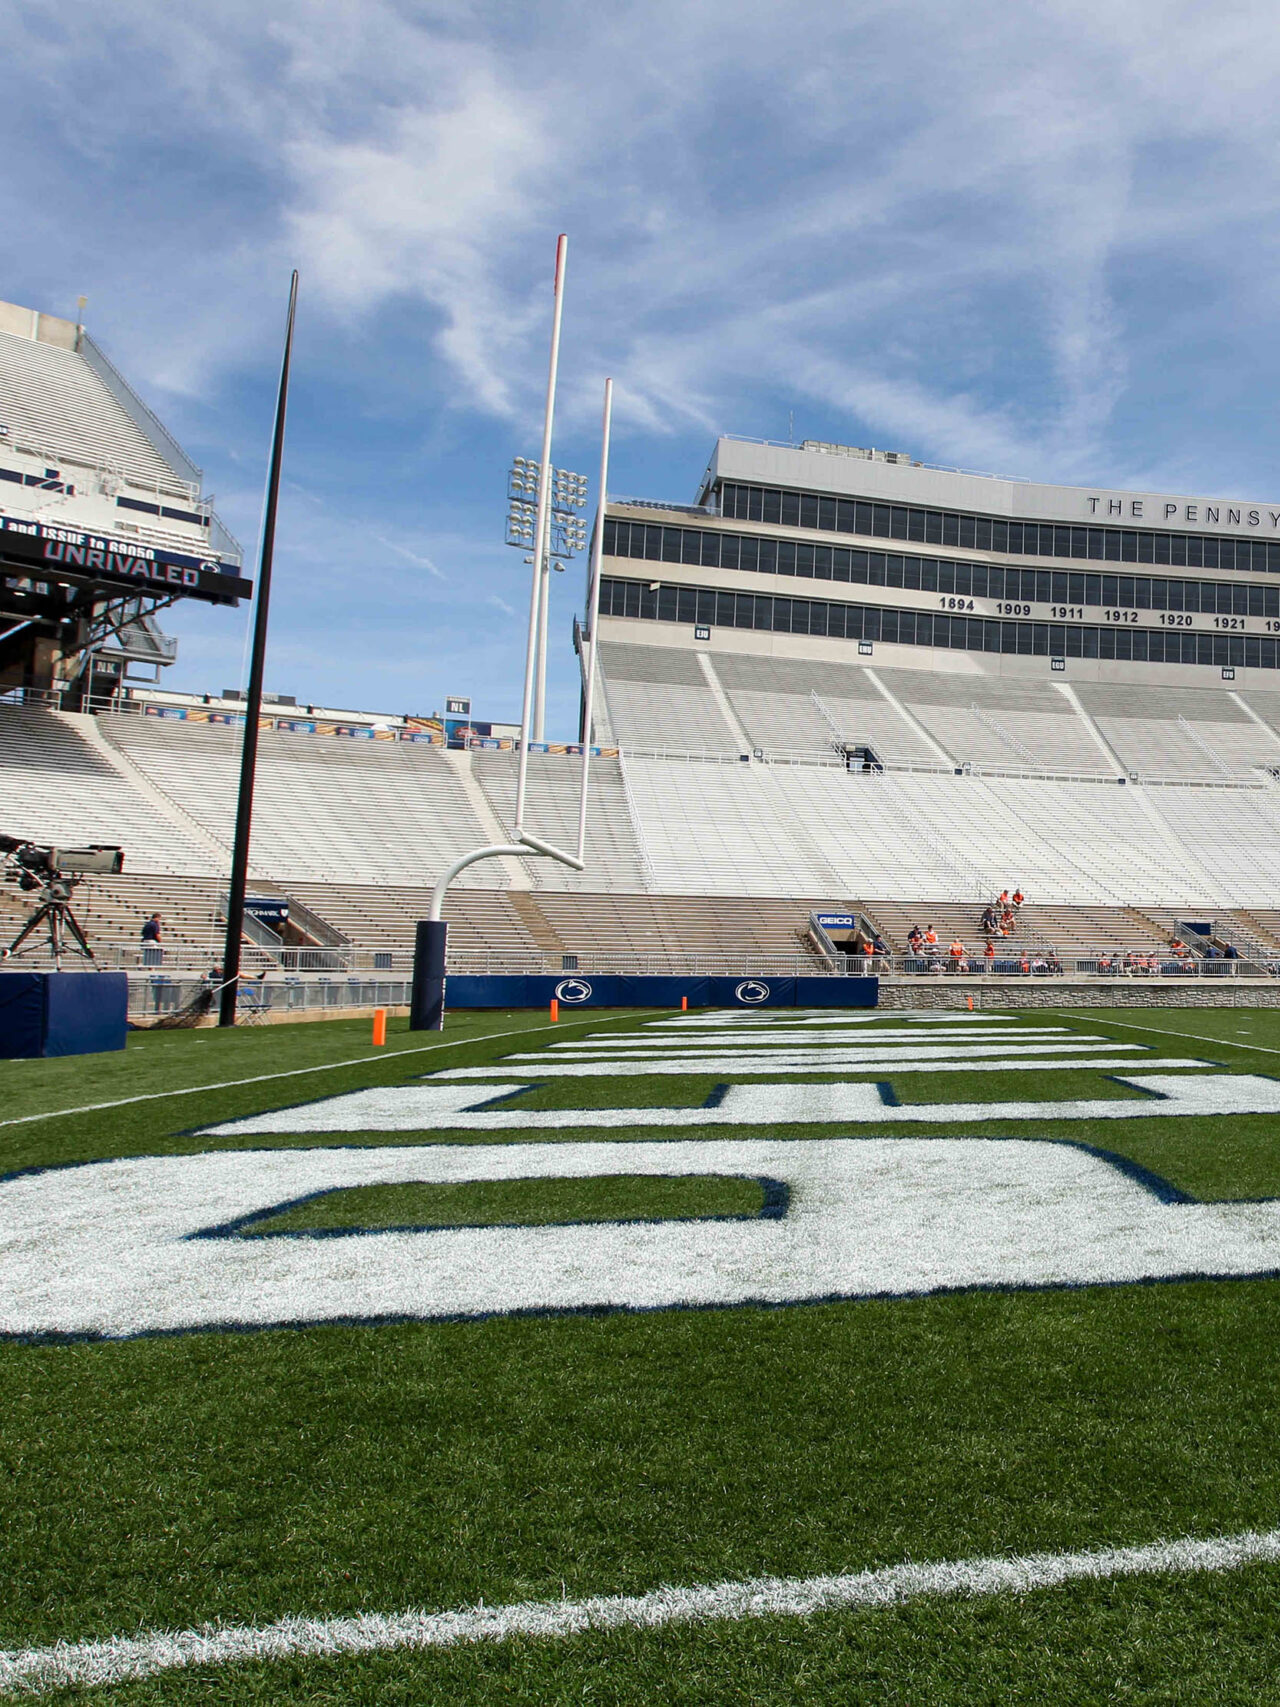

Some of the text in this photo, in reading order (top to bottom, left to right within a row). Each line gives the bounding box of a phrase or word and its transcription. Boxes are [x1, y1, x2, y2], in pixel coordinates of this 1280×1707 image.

[1087, 497, 1143, 517] THE
[7, 522, 38, 537] and
[44, 541, 200, 587] UNRIVALED
[938, 597, 975, 612] 1894
[996, 602, 1031, 616] 1909
[1050, 606, 1083, 619] 1911
[1104, 610, 1139, 623] 1912
[1159, 613, 1193, 626] 1920
[1213, 617, 1246, 629] 1921
[96, 660, 115, 673] NK
[450, 702, 465, 713] NL
[820, 916, 853, 925] GEICO
